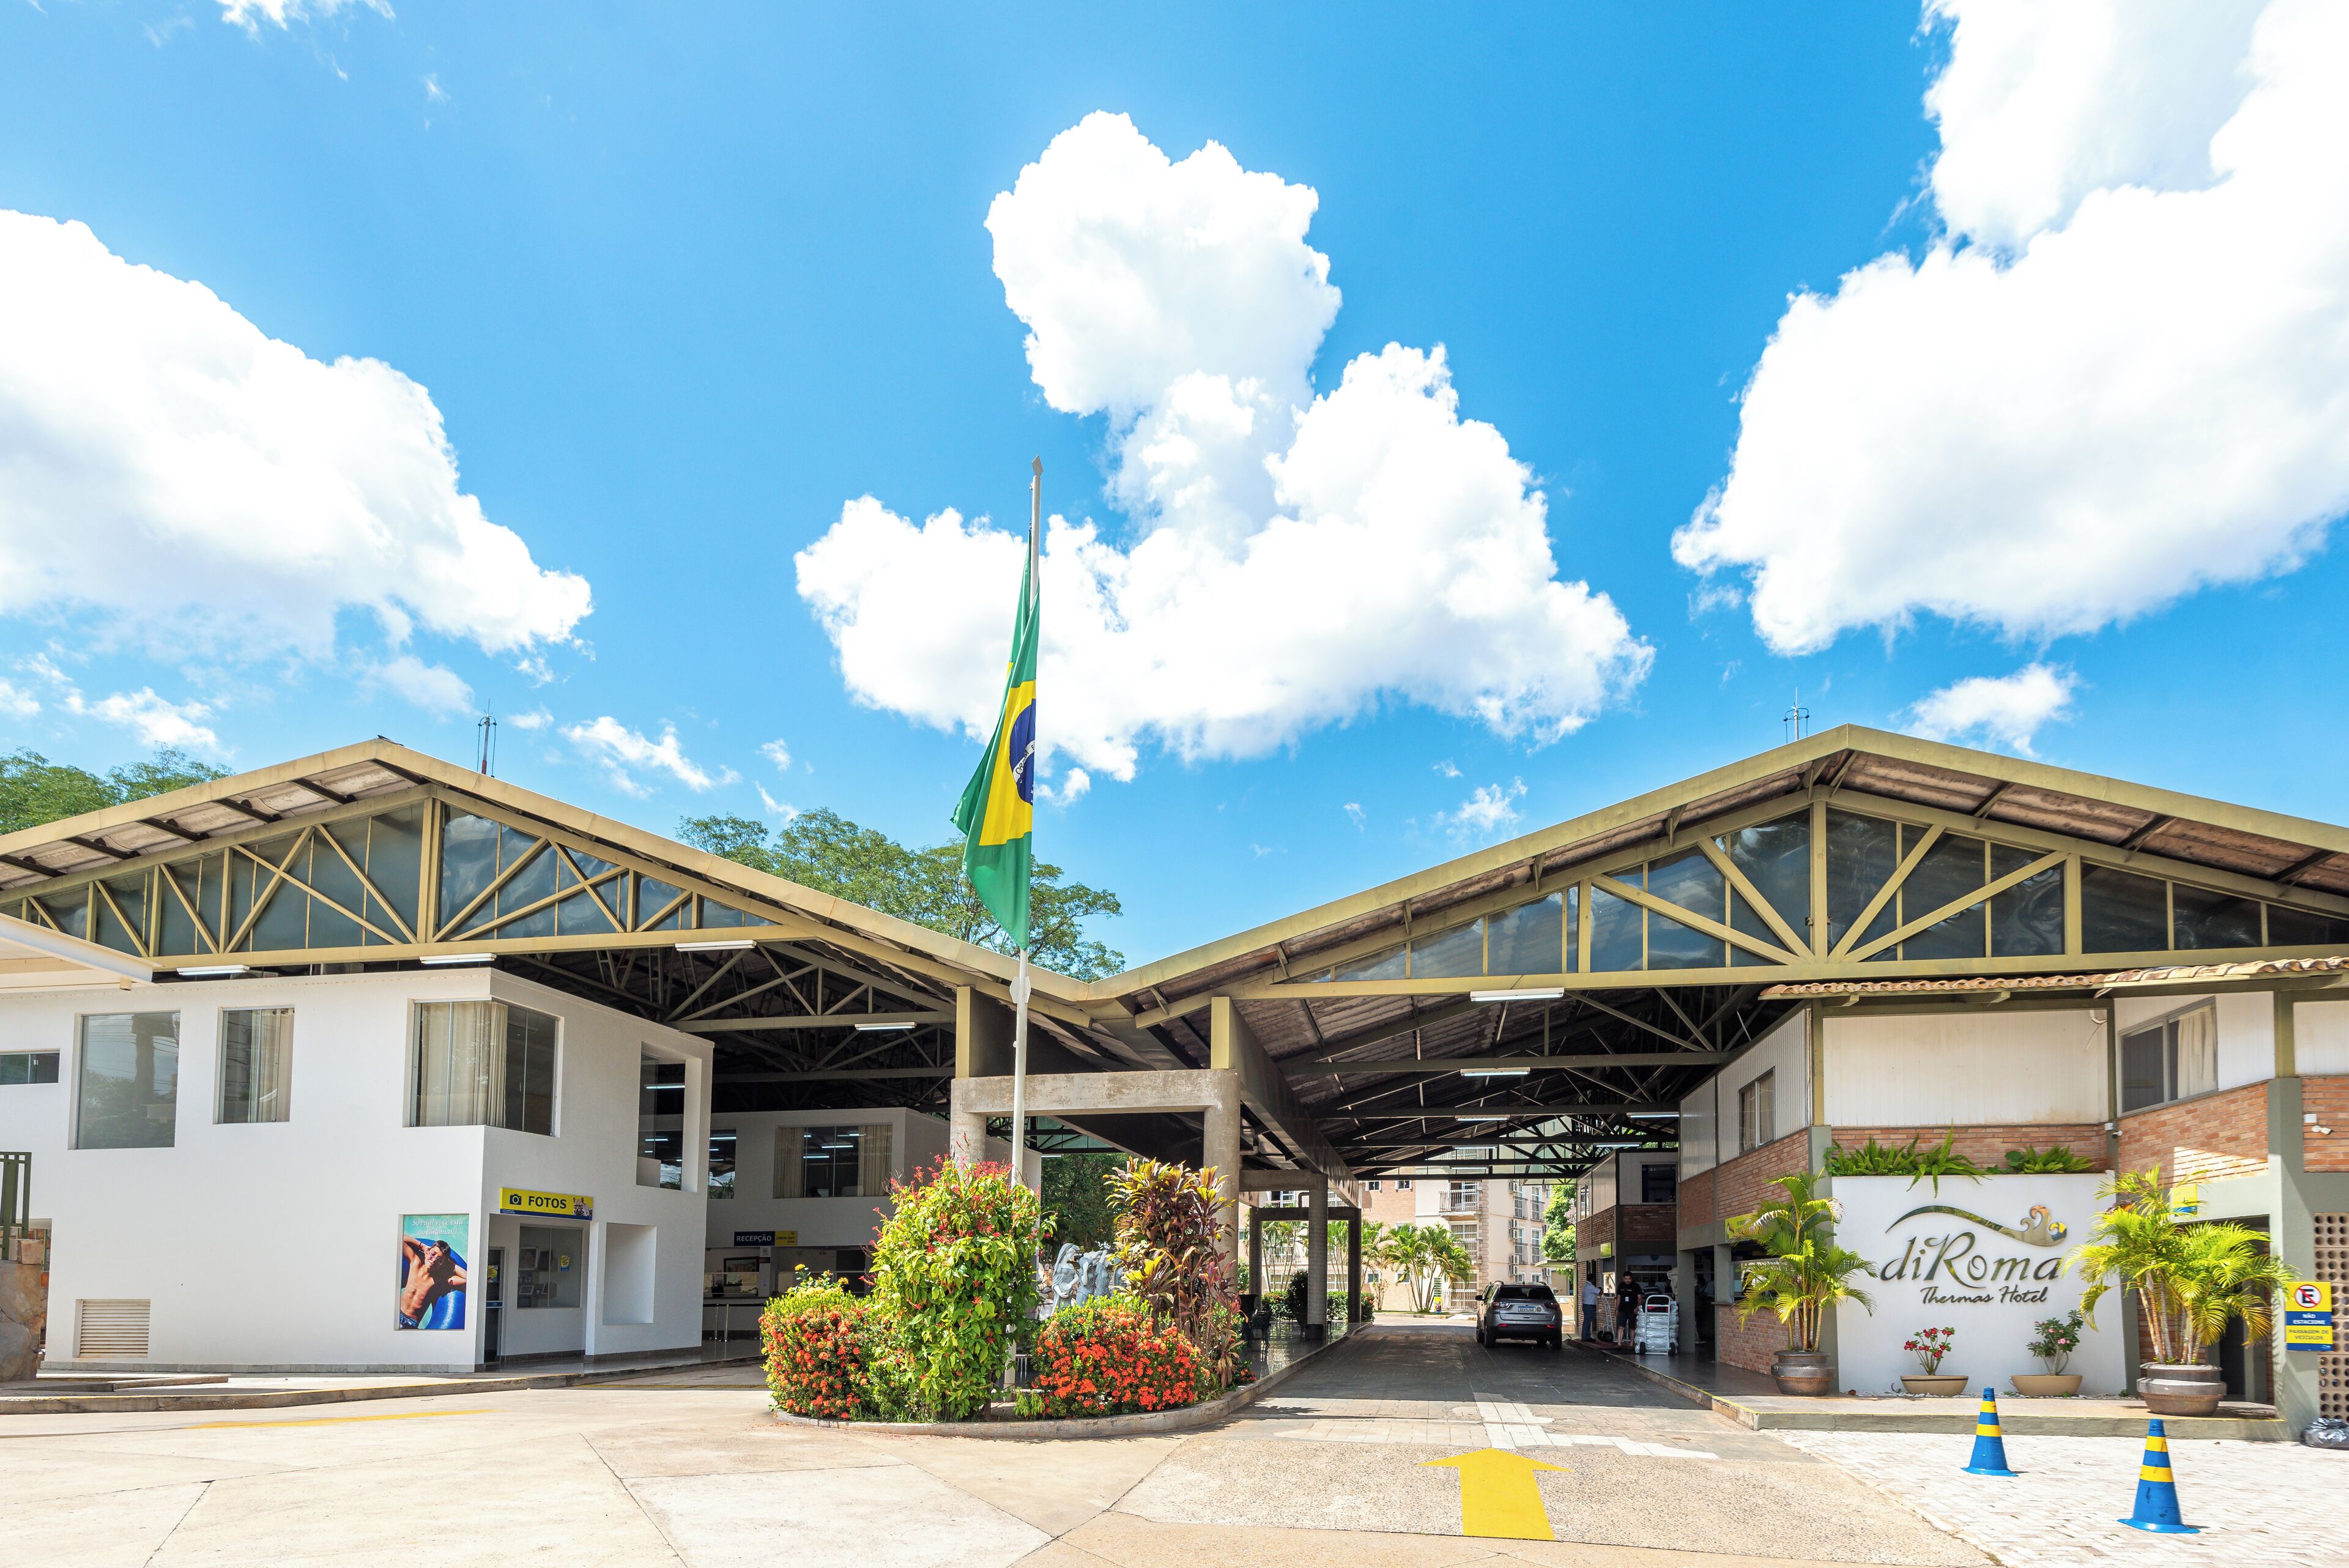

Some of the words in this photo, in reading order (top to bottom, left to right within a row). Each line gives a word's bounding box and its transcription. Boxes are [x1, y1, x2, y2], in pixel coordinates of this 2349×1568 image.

[528, 1195, 567, 1209] FOTOS
[737, 1233, 772, 1243] RECEPÇÃO
[1879, 1232, 2064, 1289] diRoma
[1920, 1285, 1994, 1304] Thermas
[1998, 1284, 2049, 1304] Hotel
